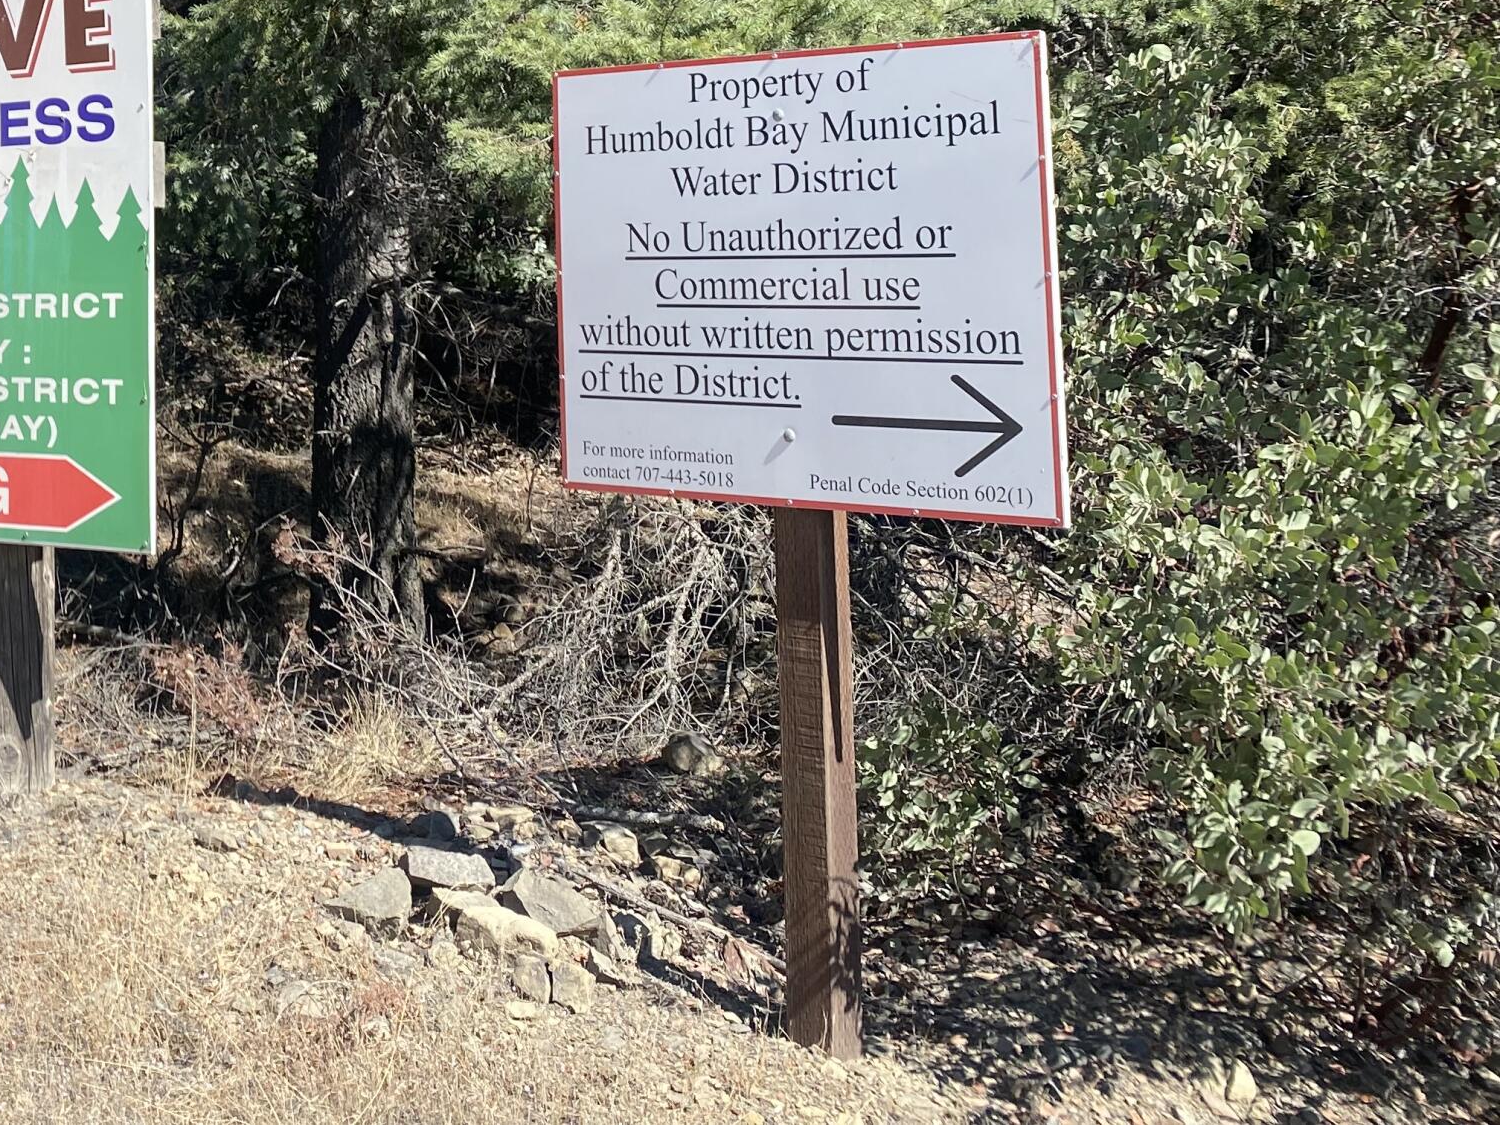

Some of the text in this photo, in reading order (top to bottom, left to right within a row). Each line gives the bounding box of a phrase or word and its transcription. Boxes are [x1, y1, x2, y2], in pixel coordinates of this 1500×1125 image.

[688, 58, 875, 108] Property of
[584, 101, 1001, 156] Humboldt Bay Municipal
[670, 159, 898, 198] Water District
[624, 216, 953, 254] No Unauthorized or
[655, 267, 921, 302] Commercial use
[579, 314, 1023, 359] without written permission
[581, 362, 801, 402] of the District.
[583, 440, 733, 465] For more information
[583, 466, 734, 487] contact 707-443-5018
[809, 474, 851, 492] Penal
[858, 478, 900, 495] Code
[906, 480, 969, 501] Section
